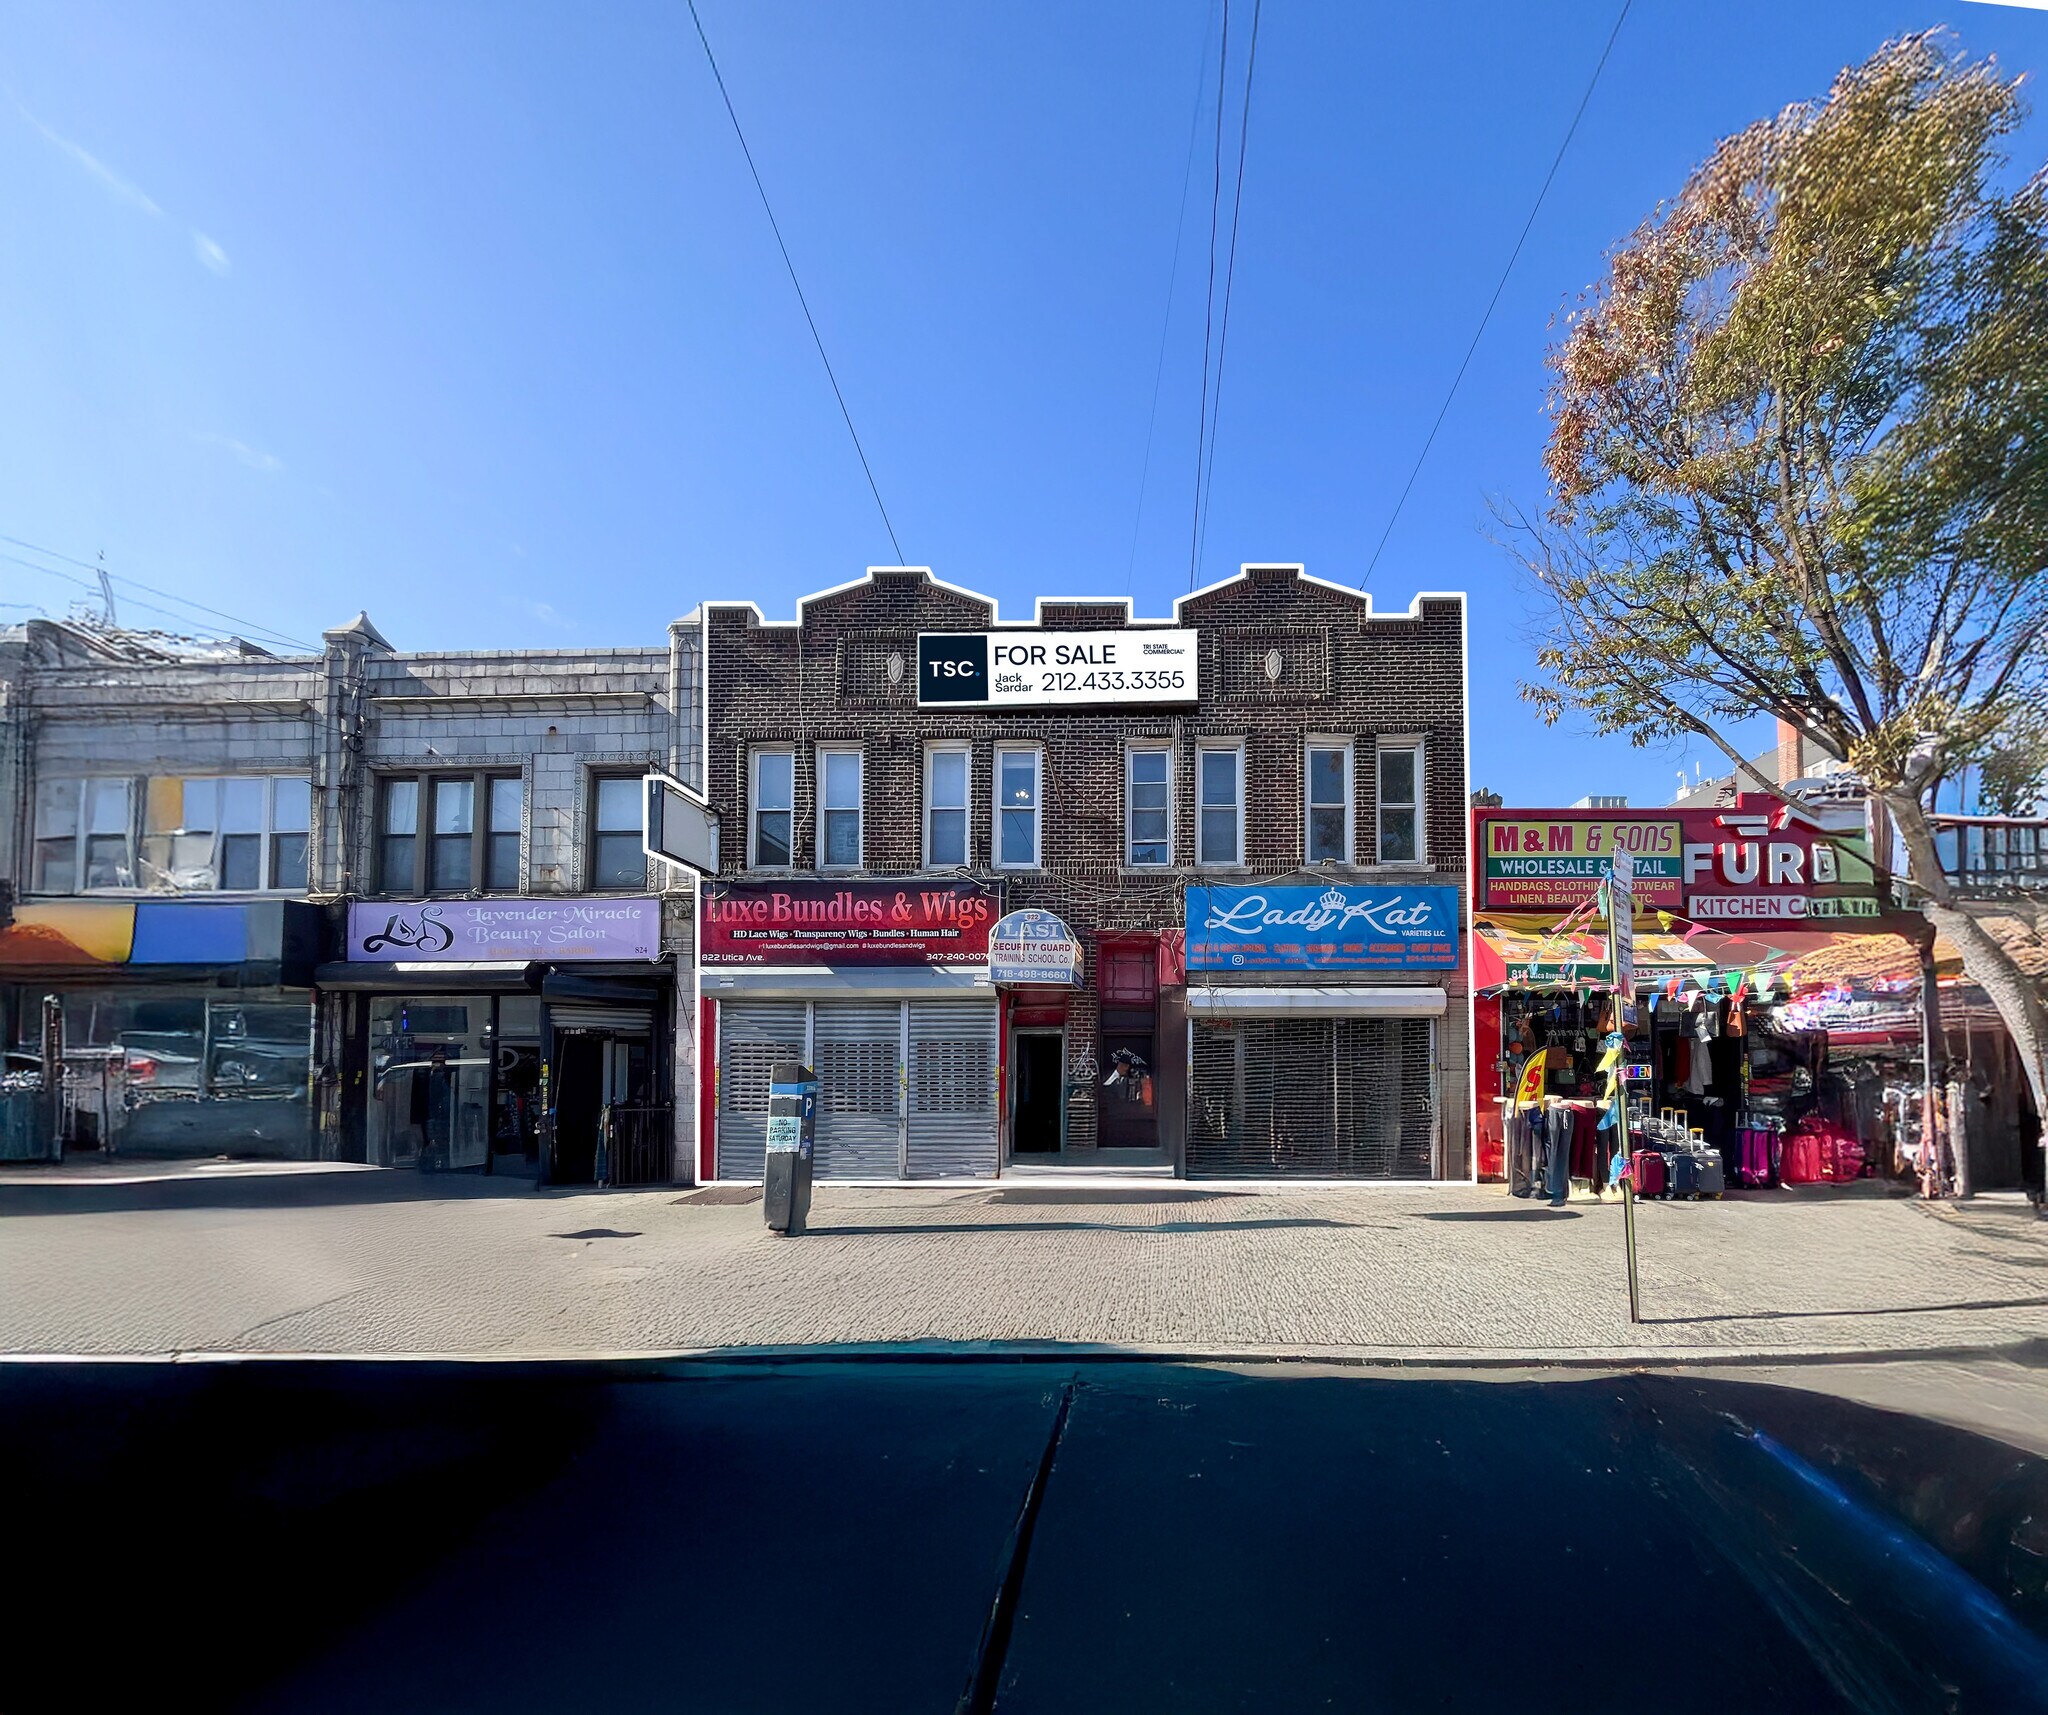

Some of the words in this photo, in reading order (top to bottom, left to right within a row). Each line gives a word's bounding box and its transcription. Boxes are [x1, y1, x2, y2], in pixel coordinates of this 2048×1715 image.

[994, 645, 1047, 666] FOR
[1055, 644, 1116, 665] SALE
[929, 660, 980, 677] TSC.
[995, 673, 1022, 683] Jack
[1041, 671, 1185, 691] 212.433.3355
[995, 682, 1033, 692] Sardar
[1494, 825, 1573, 852] M&M
[1586, 825, 1602, 852] &
[1611, 825, 1675, 852] SONS
[1500, 860, 1594, 875] WHOLESALE
[1599, 860, 1611, 875] &
[1684, 842, 1822, 885] FUR
[1490, 881, 1553, 892] HANDBAGS,
[1510, 894, 1546, 905] LINEN,
[1547, 894, 1588, 904] BEAUTY
[1696, 898, 1780, 915] KITCHEN
[466, 906, 557, 926] Lavender
[563, 905, 642, 923] Miracle
[705, 892, 768, 922] Luxe
[771, 891, 883, 923] Bundles
[891, 892, 912, 922] &
[920, 891, 988, 929] Wigs
[1204, 895, 1337, 935] Lady
[1337, 895, 1432, 935] Kat
[466, 926, 542, 945] Beauty
[548, 926, 606, 943] Salon
[733, 930, 747, 938] HD
[748, 930, 768, 938] Lace
[769, 930, 789, 940] Wigs
[793, 930, 847, 939] Transparency
[848, 930, 868, 939] Wigs
[873, 929, 905, 938] Bundles
[910, 929, 939, 937] Human
[940, 929, 960, 937] Hair
[1003, 923, 1059, 937] LASI
[1401, 929, 1431, 937] VARIETIES
[993, 943, 1037, 951] SECURITY
[1040, 943, 1071, 952] GUARD
[701, 953, 720, 961] 822
[721, 953, 744, 961] Utica
[745, 953, 765, 961] Ave.
[995, 953, 1025, 962] TRAINING
[1028, 953, 1056, 963] SCHOOL
[1058, 954, 1070, 963] Co.
[996, 969, 1067, 979] 718-498-8660
[1628, 1066, 1650, 1078] OPEN
[805, 1098, 812, 1116] P
[769, 1126, 797, 1134] PARKING
